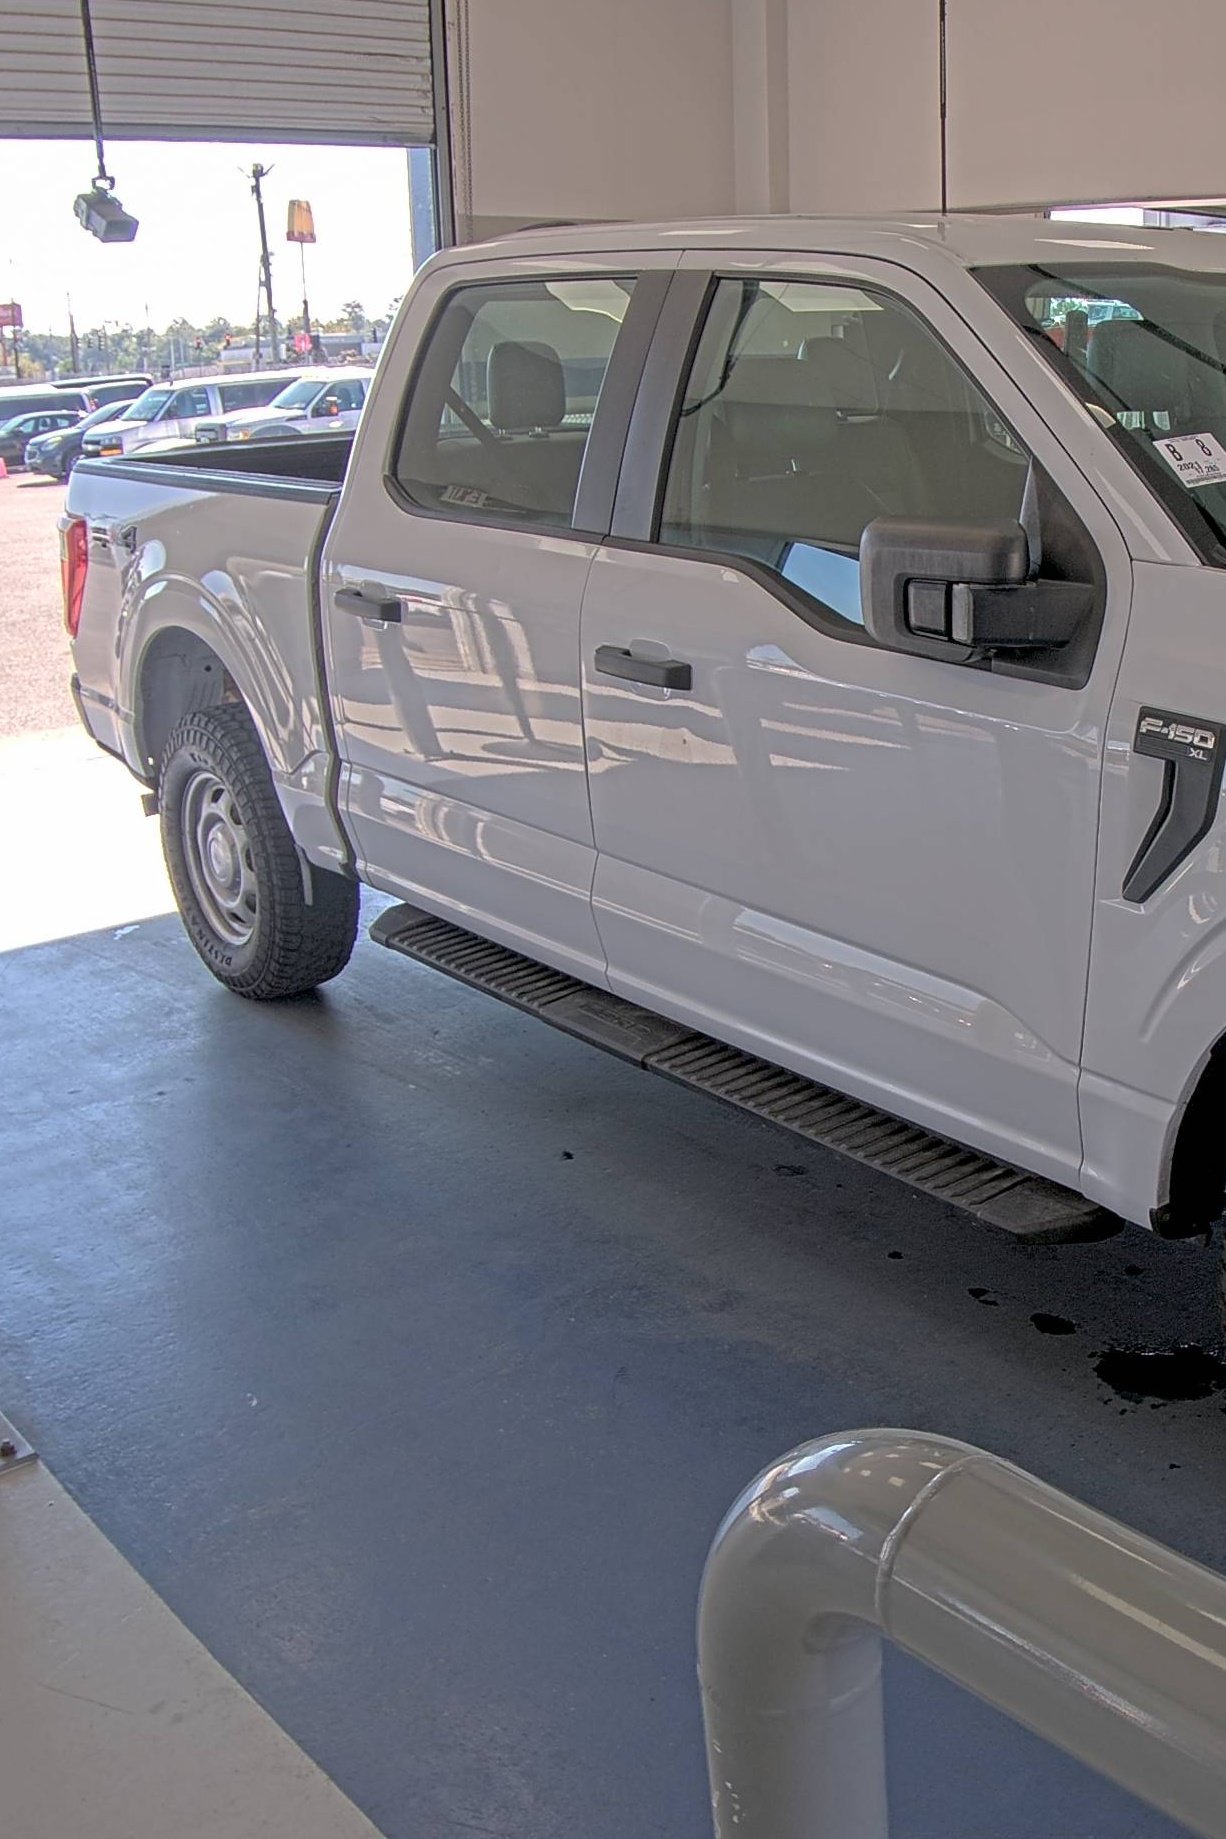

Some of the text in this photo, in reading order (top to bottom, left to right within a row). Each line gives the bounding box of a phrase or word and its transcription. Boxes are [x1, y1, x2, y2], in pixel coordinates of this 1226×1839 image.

[1195, 438, 1211, 456] 8
[1139, 717, 1216, 749] F-150
[1188, 748, 1207, 760] XL
